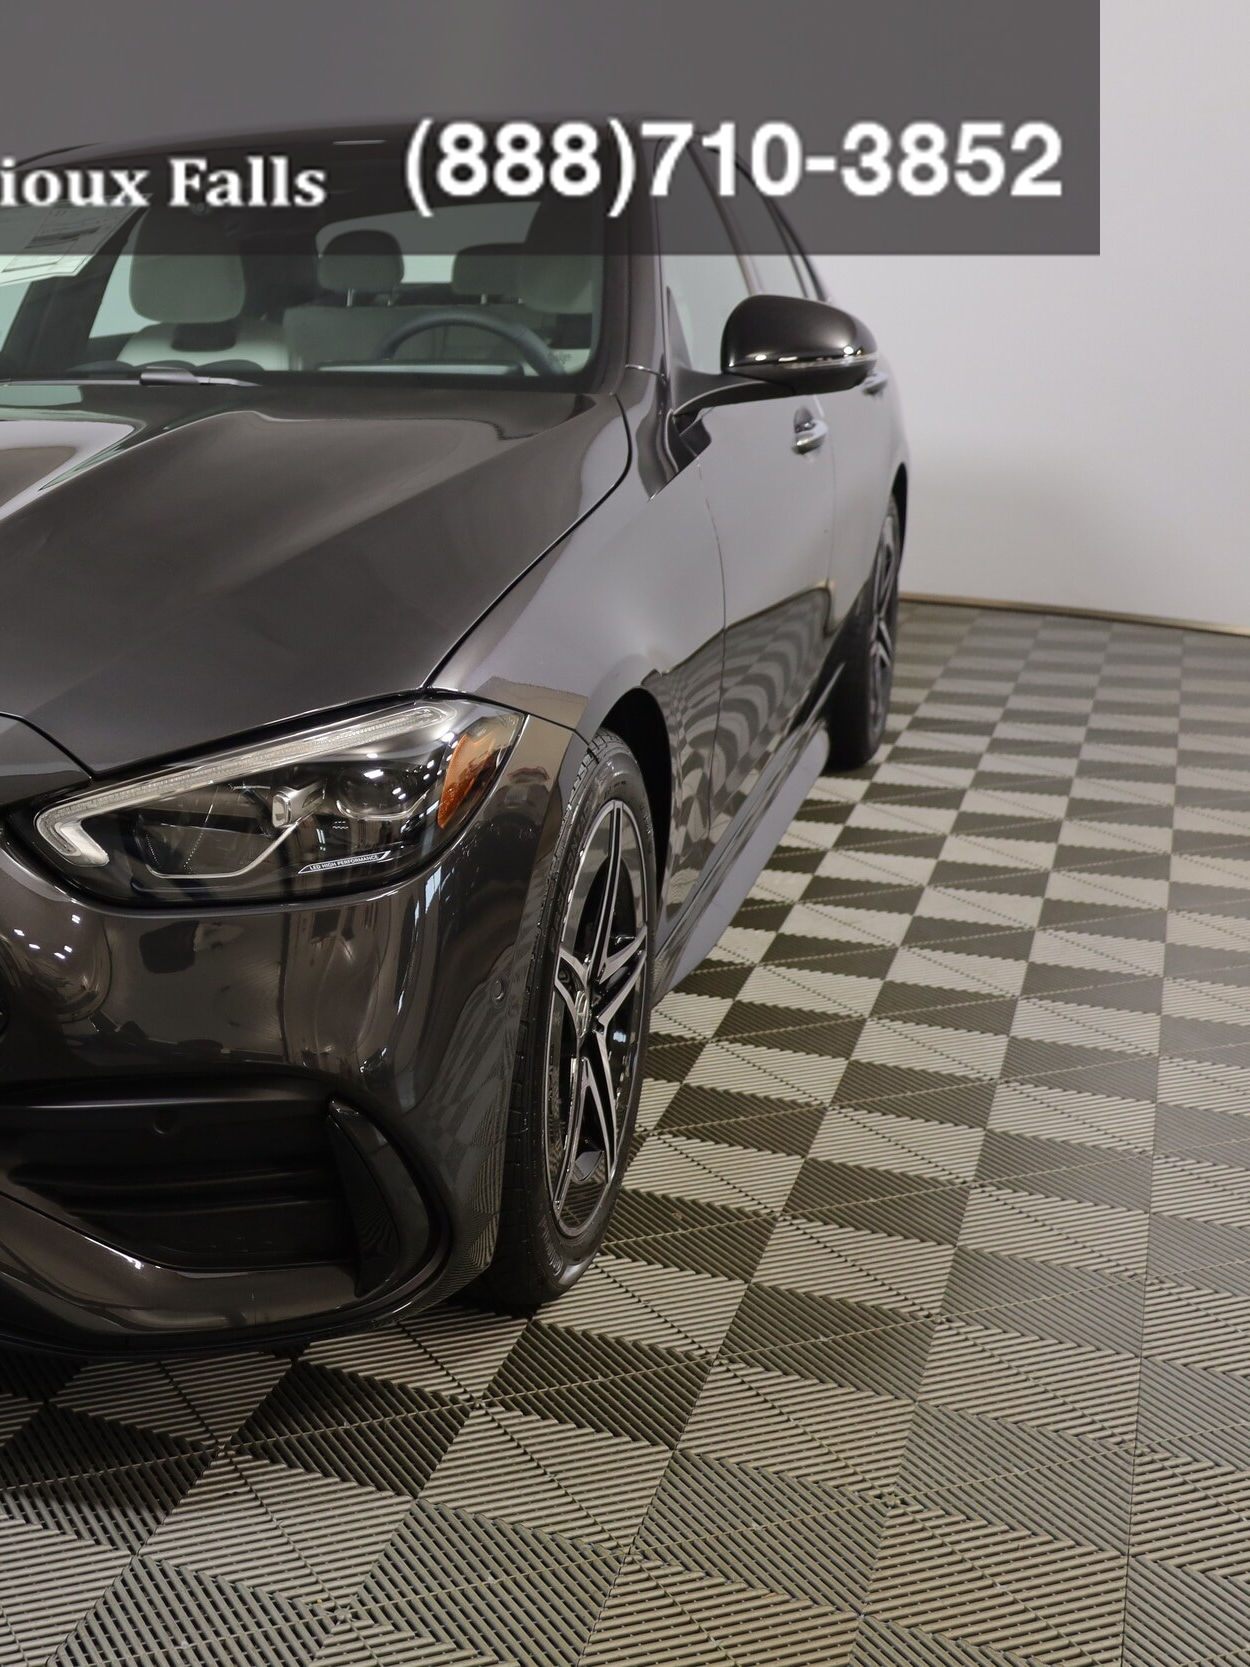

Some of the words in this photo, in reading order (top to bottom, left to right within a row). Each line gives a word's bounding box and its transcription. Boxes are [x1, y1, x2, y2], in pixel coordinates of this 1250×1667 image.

[309, 863, 321, 871] LED
[321, 861, 337, 870] HIGH
[337, 854, 379, 867] PERFORMANCE
